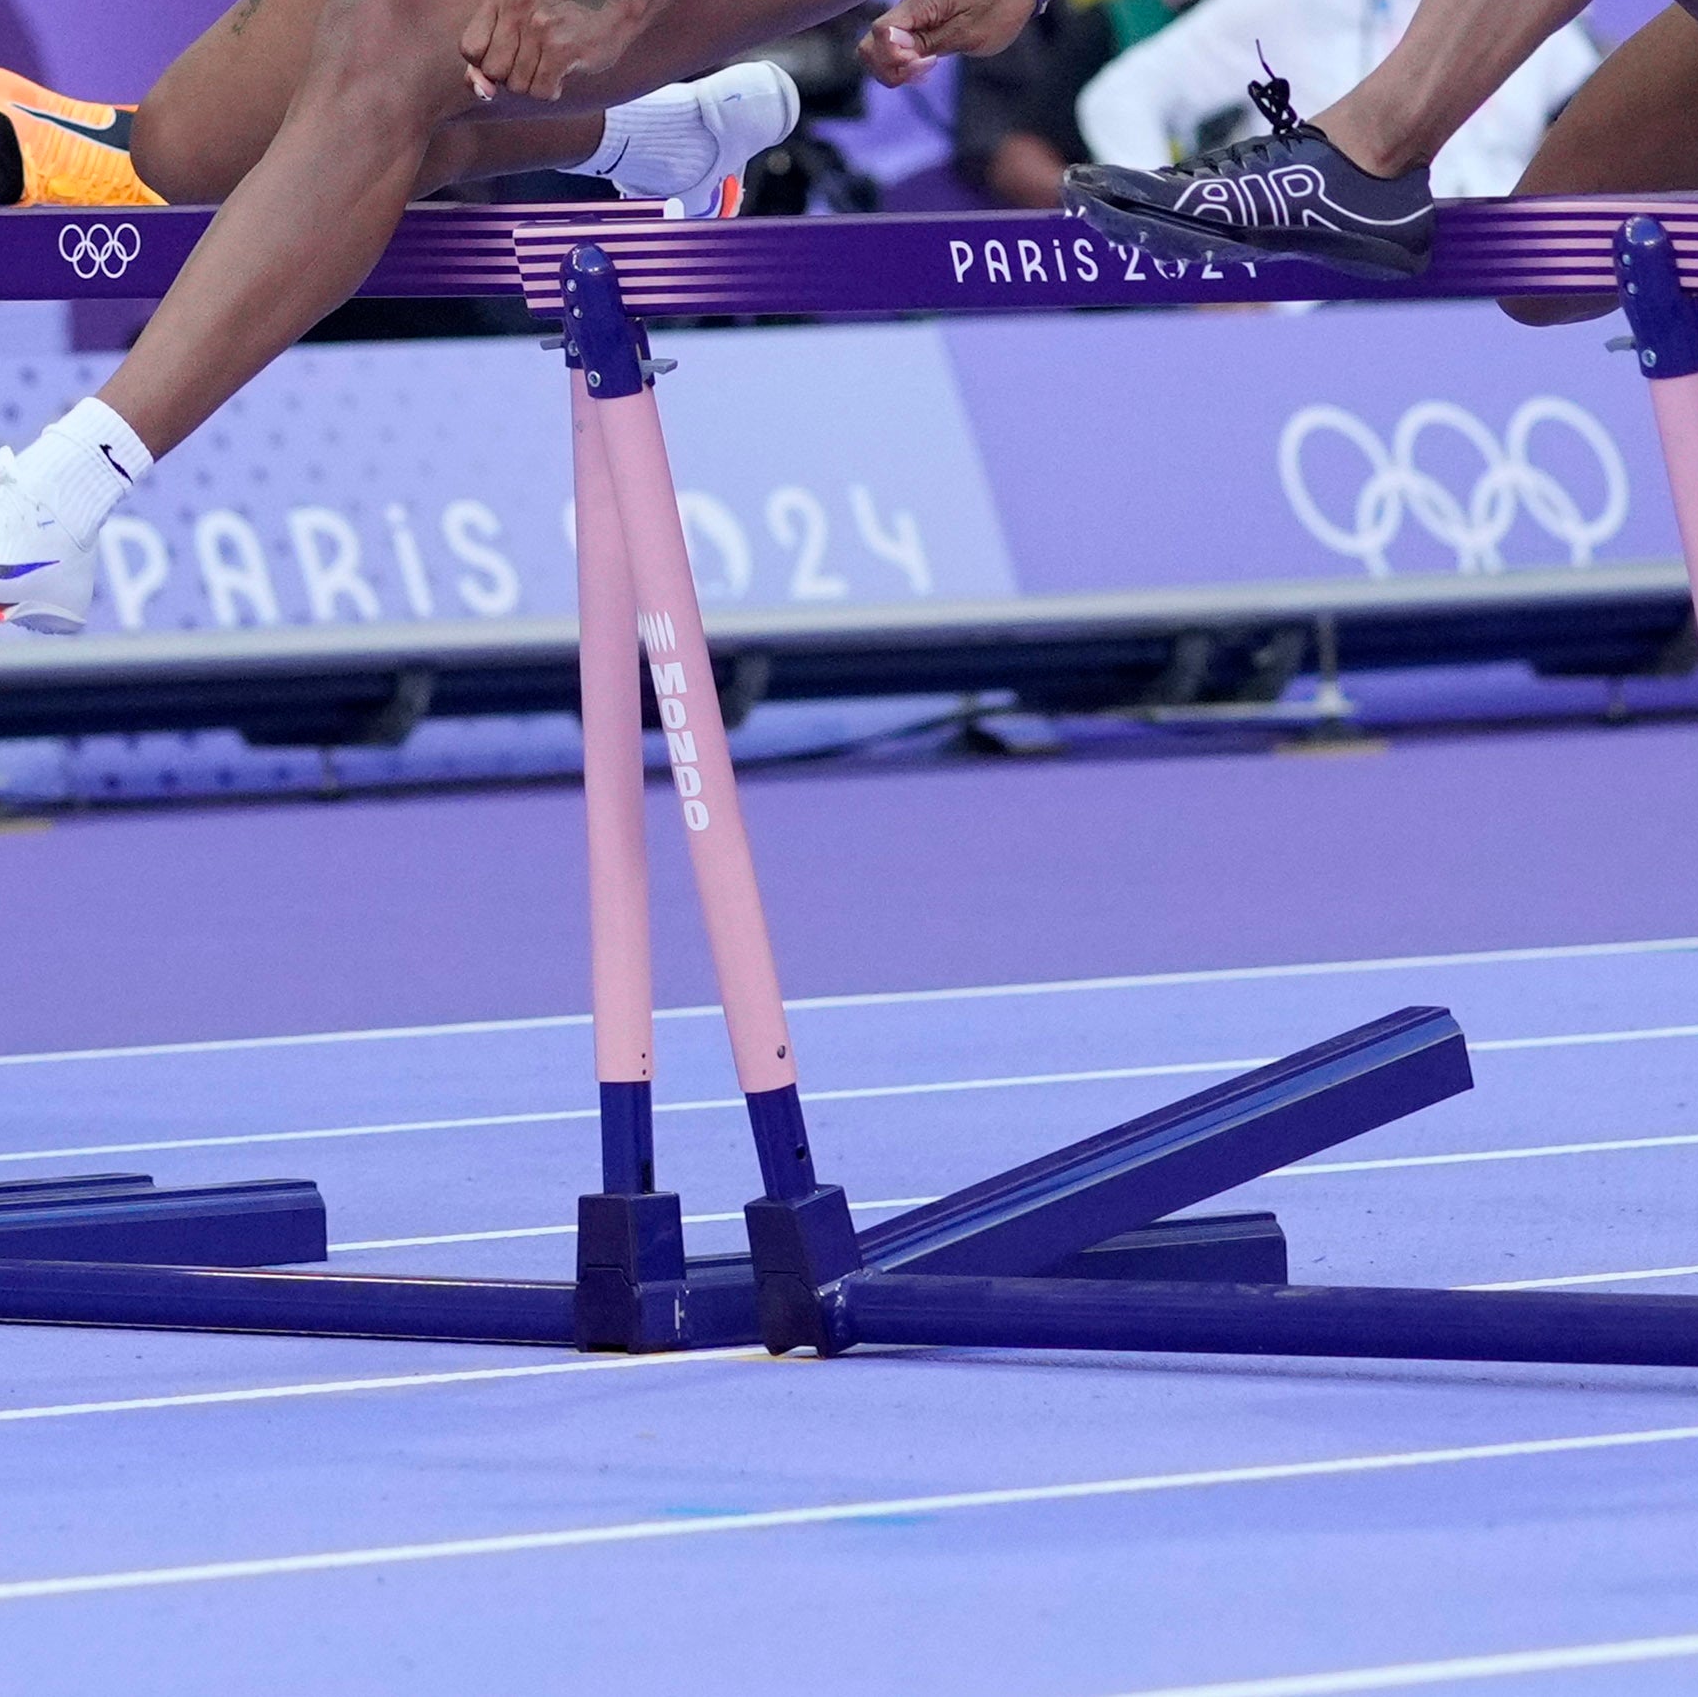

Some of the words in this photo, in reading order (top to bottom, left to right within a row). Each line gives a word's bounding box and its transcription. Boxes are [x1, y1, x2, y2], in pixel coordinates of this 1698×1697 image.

[1173, 163, 1345, 234] AIR
[565, 484, 935, 600] 024
[651, 662, 710, 832] MONDO
